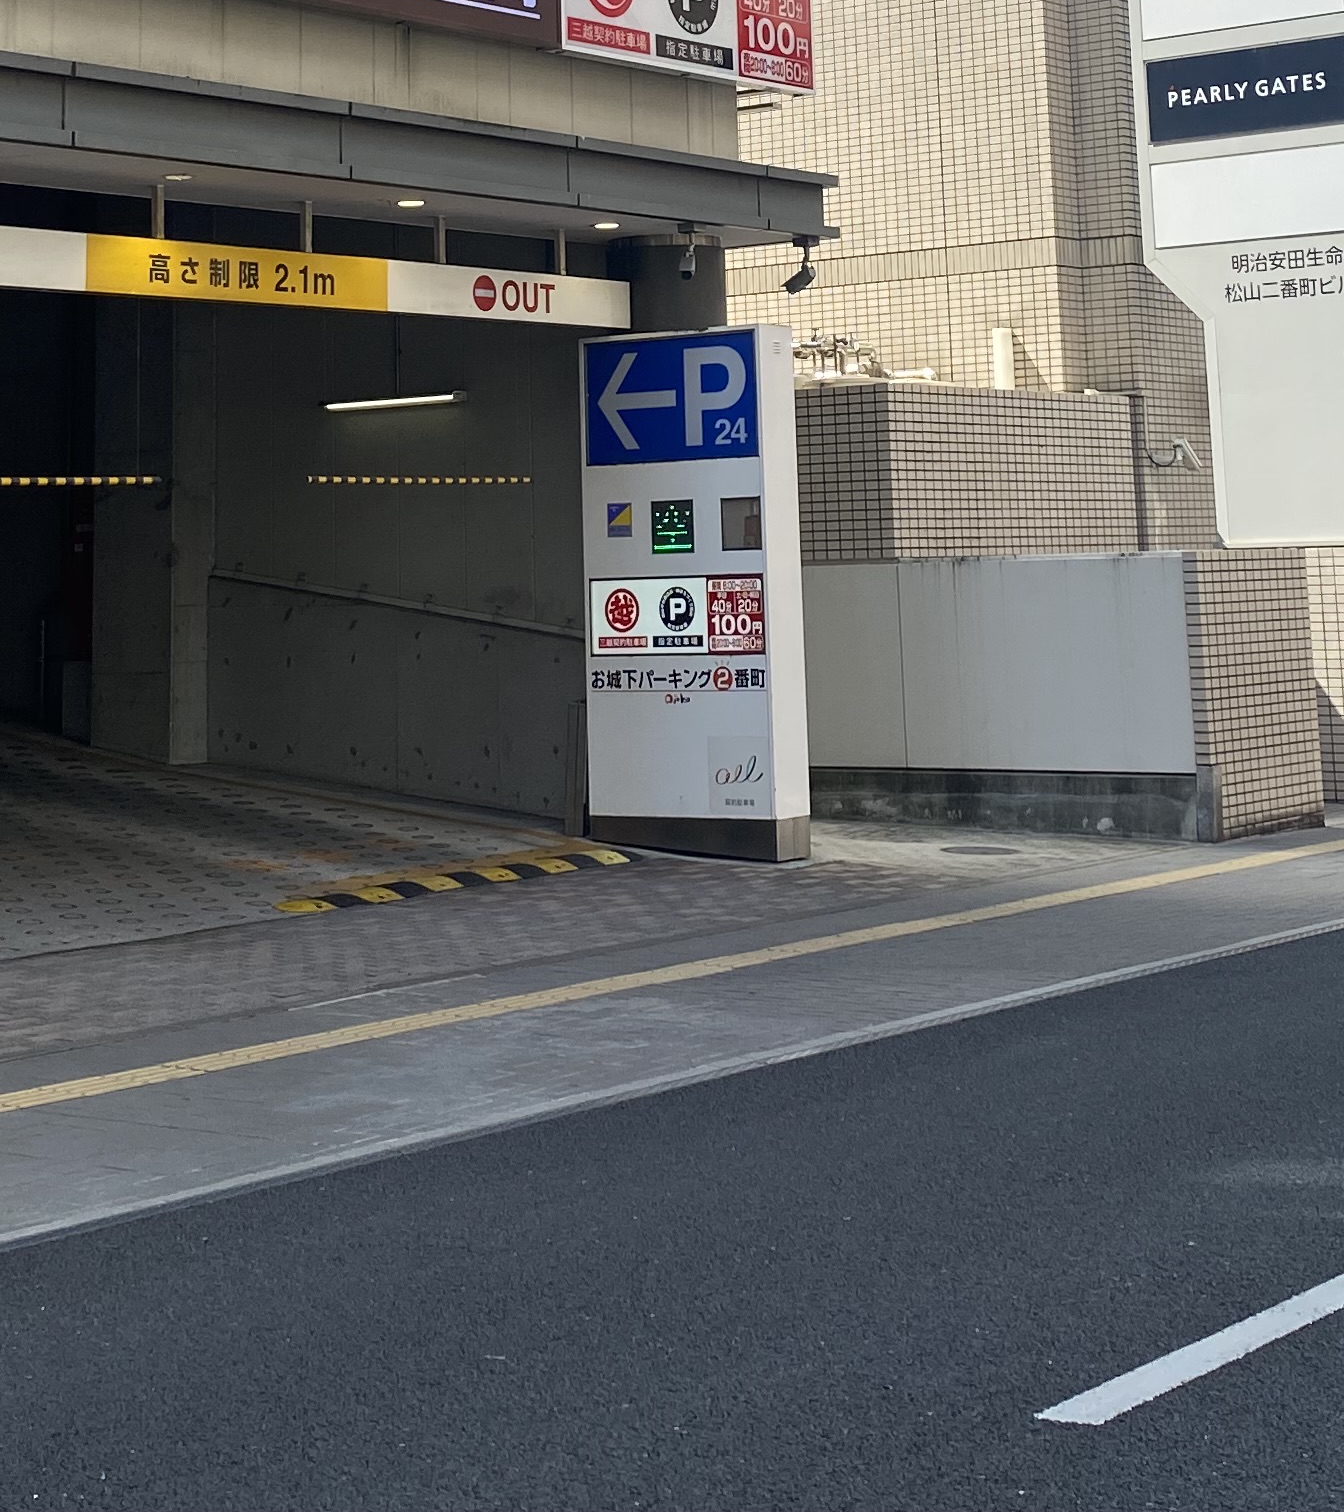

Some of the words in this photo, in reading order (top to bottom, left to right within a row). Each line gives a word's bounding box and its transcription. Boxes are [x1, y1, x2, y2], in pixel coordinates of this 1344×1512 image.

[571, 21, 647, 52] 三越契約駐車場
[744, 14, 809, 59] 100円
[665, 40, 724, 65] 指定駐車場
[1167, 81, 1249, 108] PEARLY
[1255, 71, 1326, 97] GATES
[1231, 245, 1343, 274] 明治安田生命
[147, 253, 260, 292] 高さ制限
[274, 262, 336, 299] 2.1m
[502, 282, 556, 315] OUT
[683, 345, 746, 447] P
[714, 418, 748, 445] 24
[669, 598, 686, 620] P
[711, 614, 763, 635] 100円
